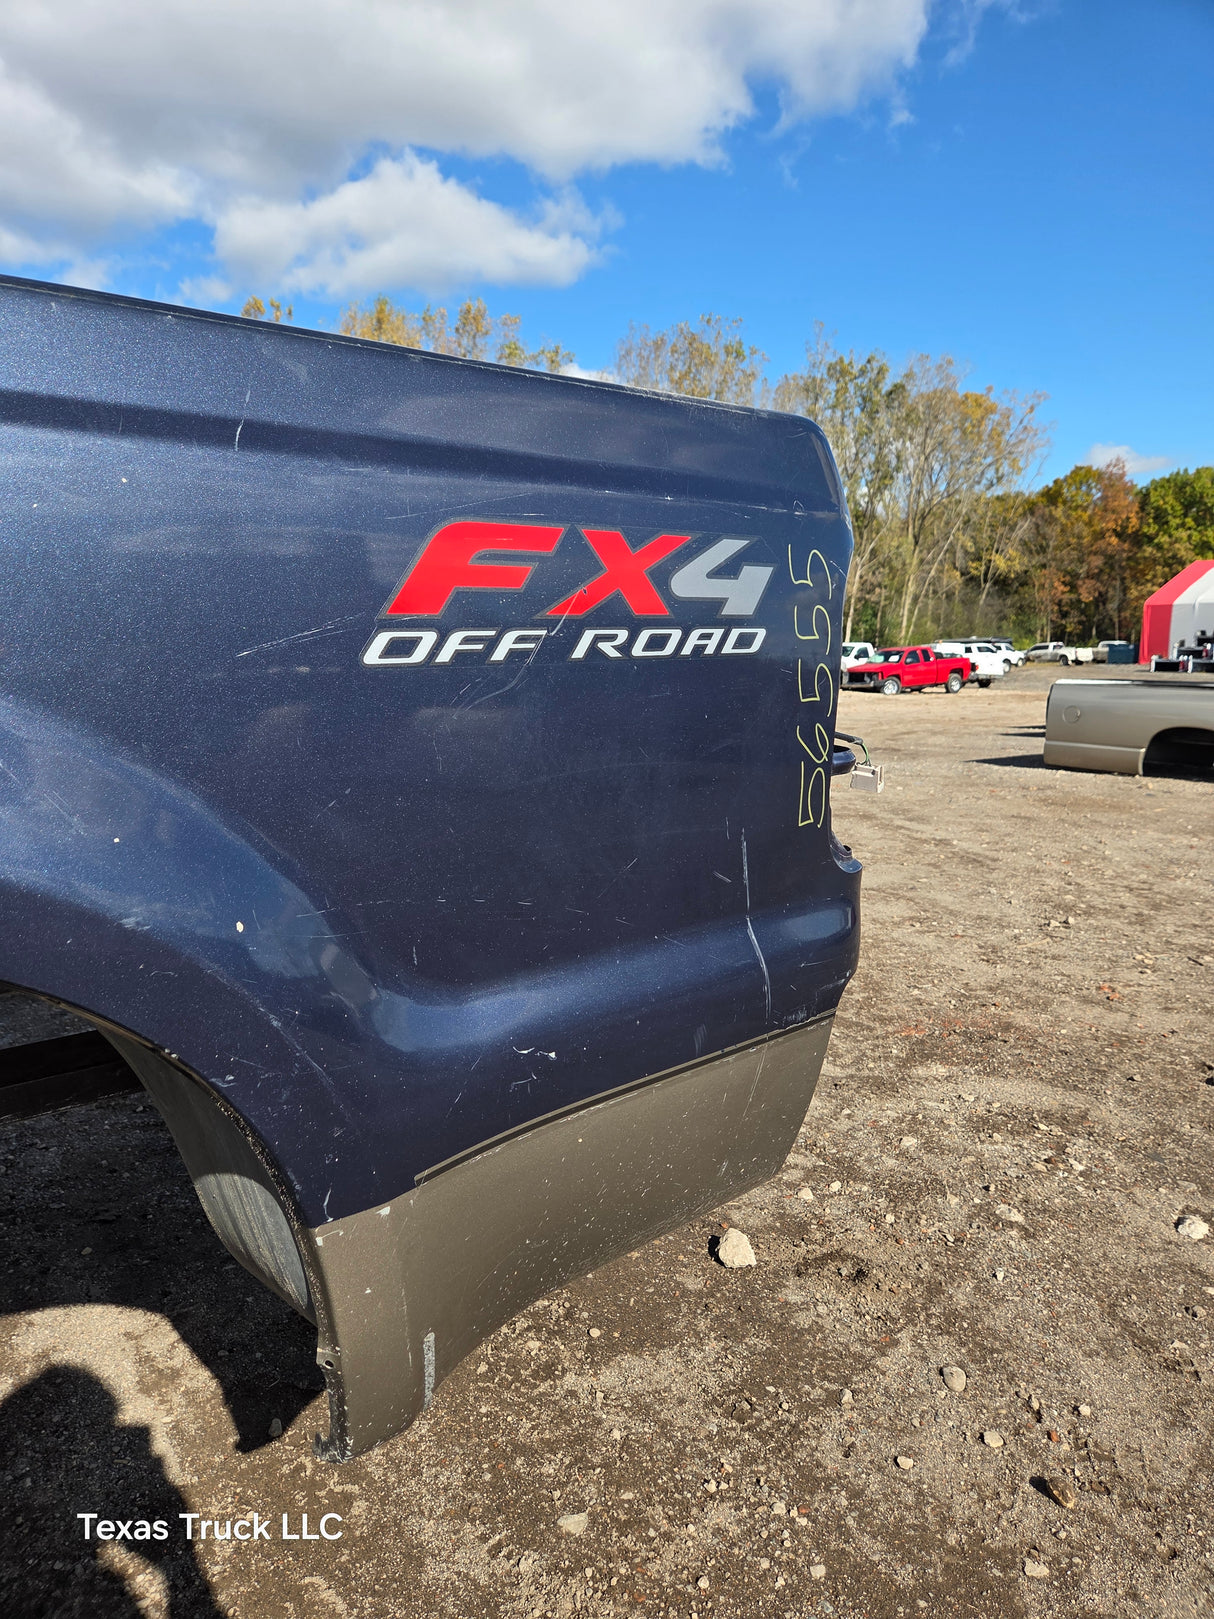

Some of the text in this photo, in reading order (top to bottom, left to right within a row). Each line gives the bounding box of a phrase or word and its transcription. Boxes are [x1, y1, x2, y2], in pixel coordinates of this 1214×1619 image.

[386, 521, 774, 616] FX4
[362, 628, 767, 665] OFF ROAD
[788, 543, 834, 829] 56555
